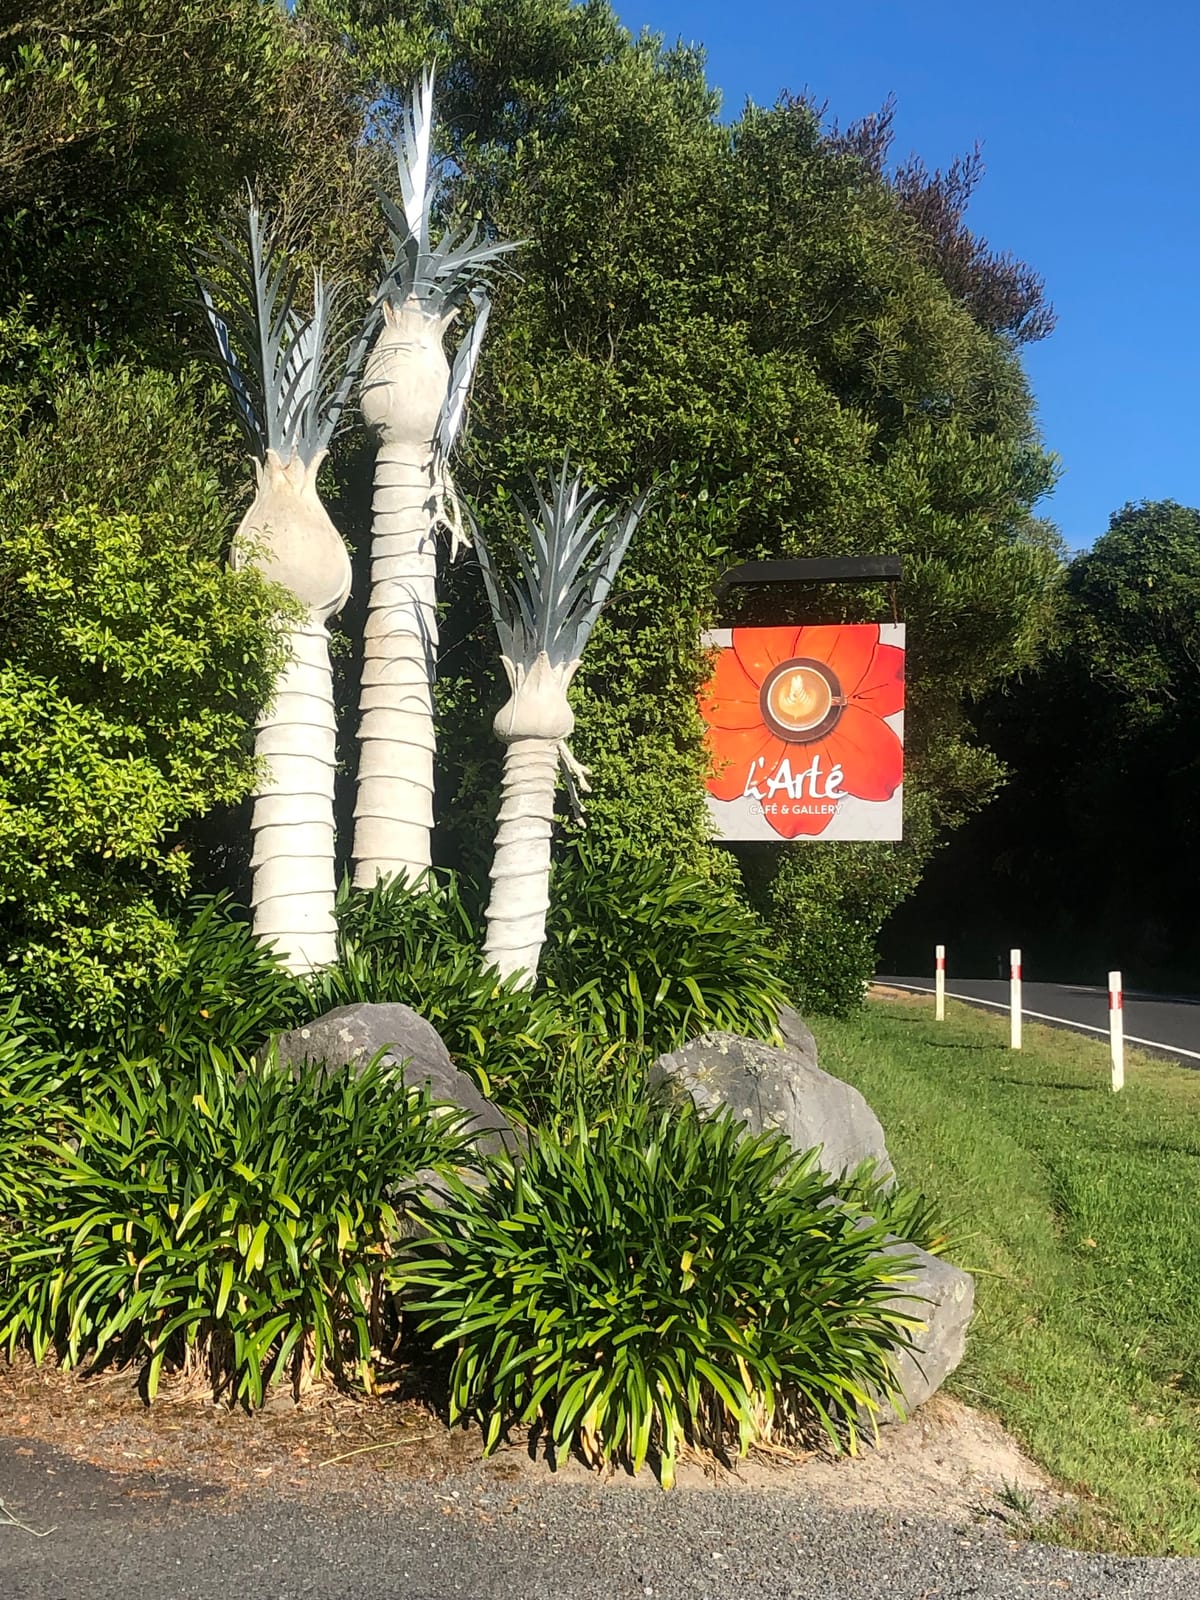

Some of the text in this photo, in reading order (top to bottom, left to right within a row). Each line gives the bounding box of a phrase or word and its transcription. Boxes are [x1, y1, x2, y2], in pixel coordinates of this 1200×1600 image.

[743, 754, 848, 800] L'Arté
[749, 803, 842, 815] CAFÉ & GALLERY
